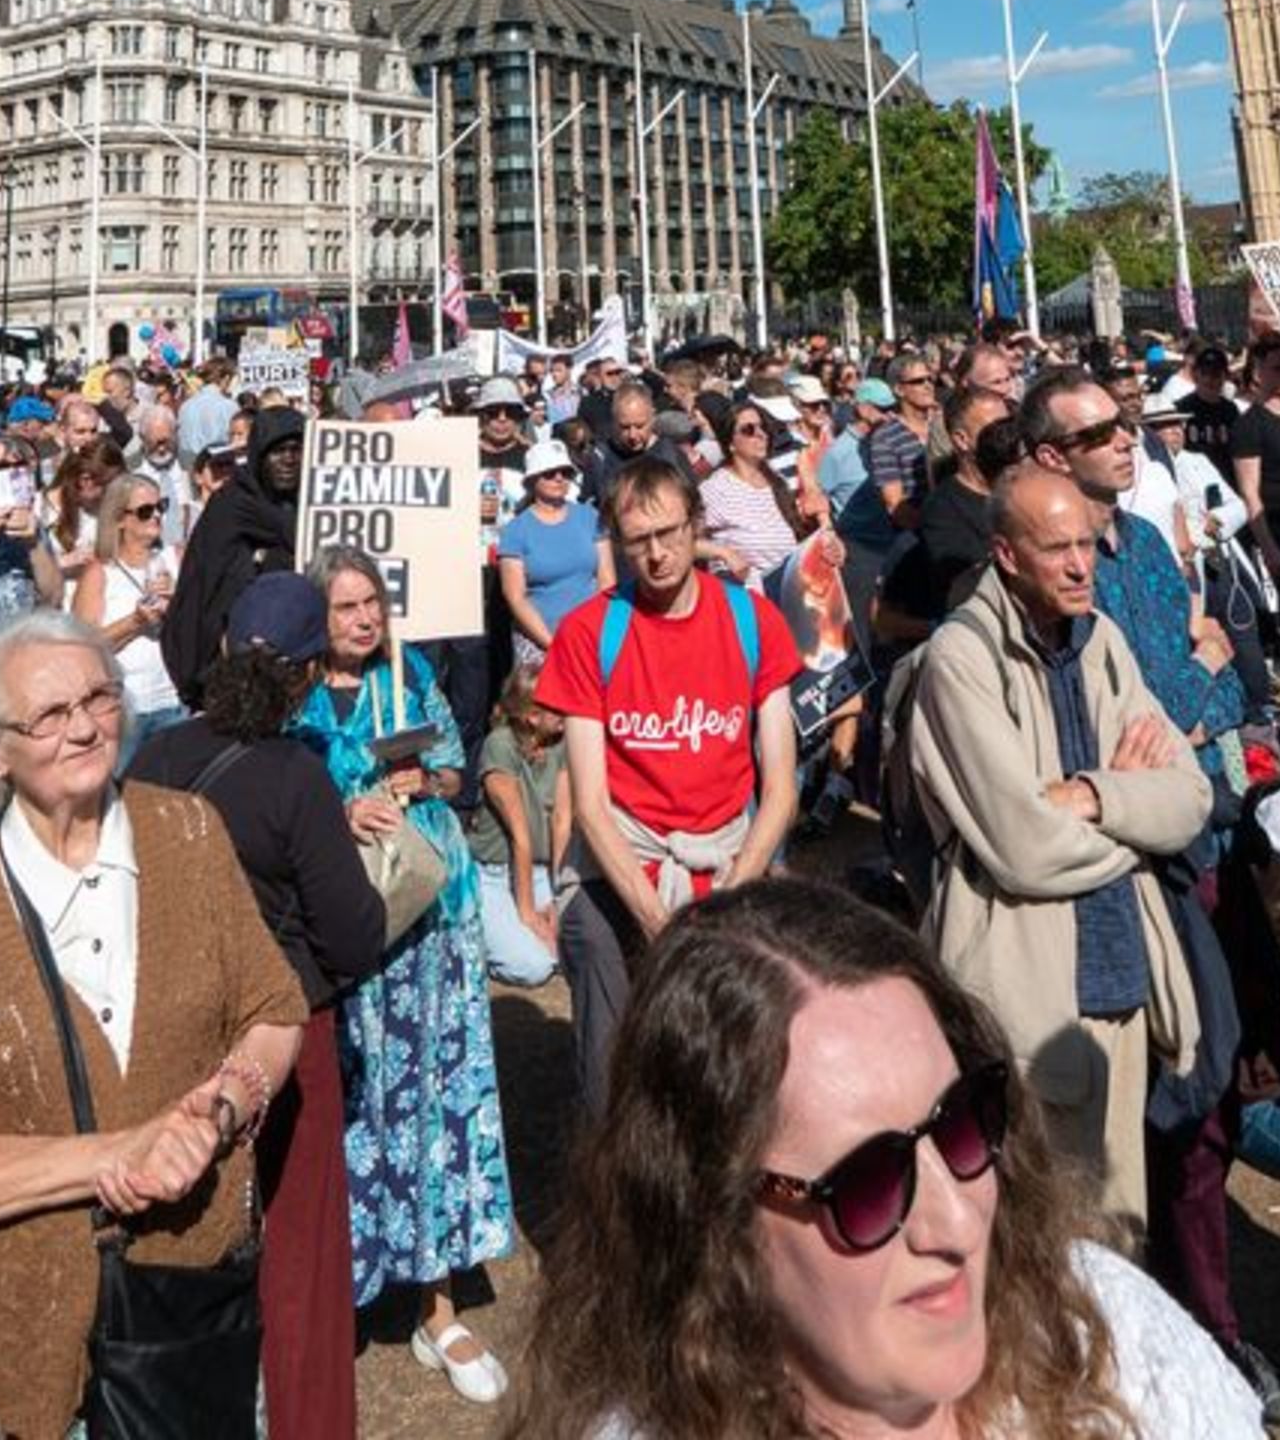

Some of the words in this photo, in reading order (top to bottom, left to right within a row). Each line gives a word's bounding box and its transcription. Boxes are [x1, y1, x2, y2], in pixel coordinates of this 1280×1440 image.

[241, 364, 308, 382] HURTS
[320, 428, 395, 465] PRO
[313, 466, 447, 505] FAMILY
[312, 509, 395, 554] PRO
